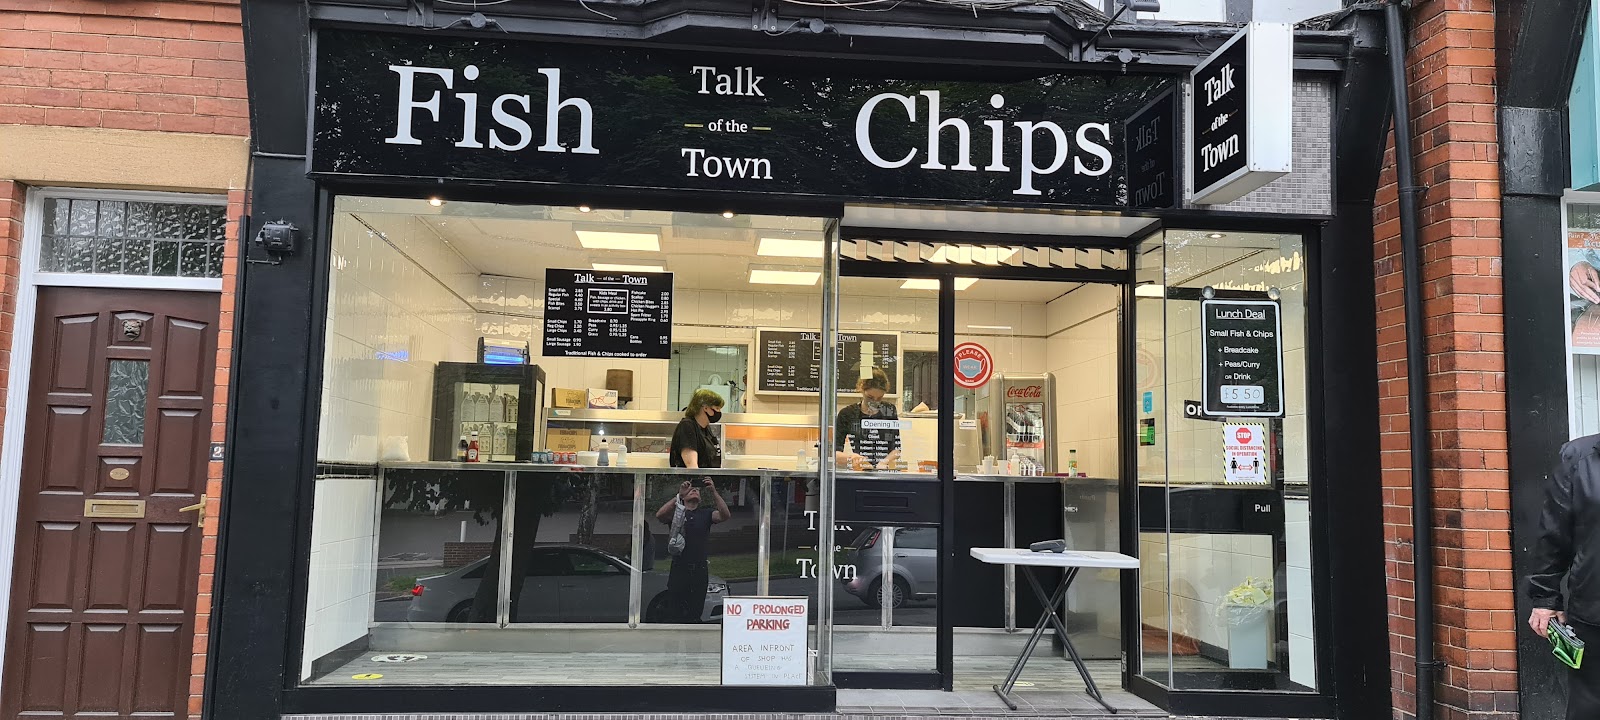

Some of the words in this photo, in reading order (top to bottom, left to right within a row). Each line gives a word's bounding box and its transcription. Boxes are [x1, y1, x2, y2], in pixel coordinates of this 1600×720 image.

[692, 66, 765, 96] Talk
[1204, 63, 1235, 106] Talk
[384, 64, 600, 155] Fish
[708, 119, 724, 132] of
[725, 120, 748, 133] the
[1211, 116, 1219, 131] of
[1218, 113, 1228, 127] the
[855, 90, 1113, 195] Chips
[1201, 134, 1239, 172] Town
[681, 148, 773, 180] Town
[574, 273, 595, 283] Talk
[622, 274, 648, 284] Town
[1216, 308, 1242, 319] Lunch
[1245, 309, 1265, 320] Deal
[1210, 329, 1228, 337] Small
[1253, 330, 1273, 338] Chips
[959, 349, 981, 359] PLEASE
[1224, 346, 1259, 354] Breadcake
[1224, 360, 1260, 369] Peas/Curry
[1007, 386, 1042, 398] Coca-Cola
[1254, 504, 1271, 512] Pull
[727, 604, 742, 615] NO
[753, 604, 805, 615] PROLONGED
[747, 619, 790, 630] PARKING
[732, 645, 754, 653] AREA
[760, 644, 795, 652] INFRONT
